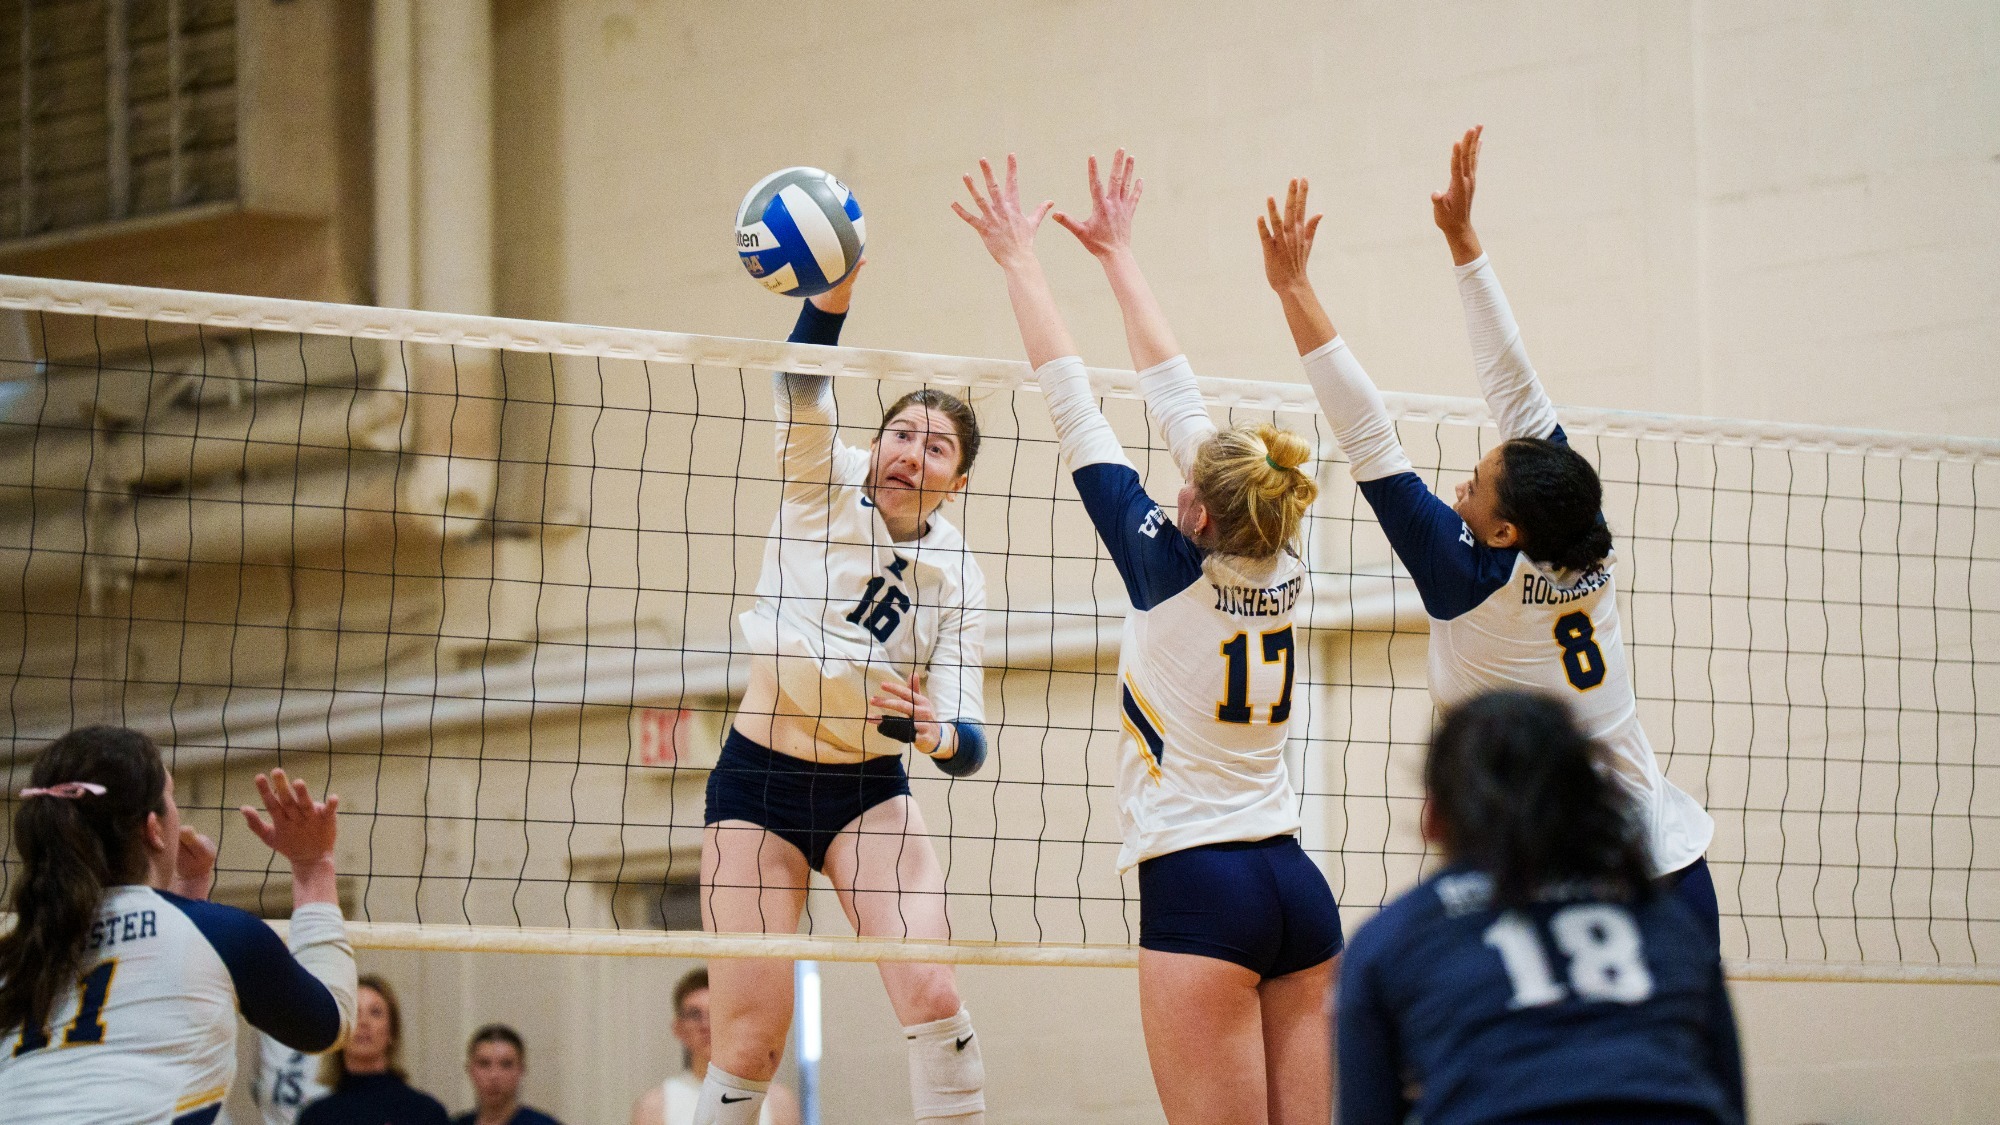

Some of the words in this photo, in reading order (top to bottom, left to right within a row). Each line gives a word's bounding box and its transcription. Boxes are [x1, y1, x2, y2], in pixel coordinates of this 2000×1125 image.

[846, 576, 911, 643] 16
[1551, 608, 1608, 694] 8
[1215, 622, 1296, 726] 17
[1483, 903, 1657, 1009] 18
